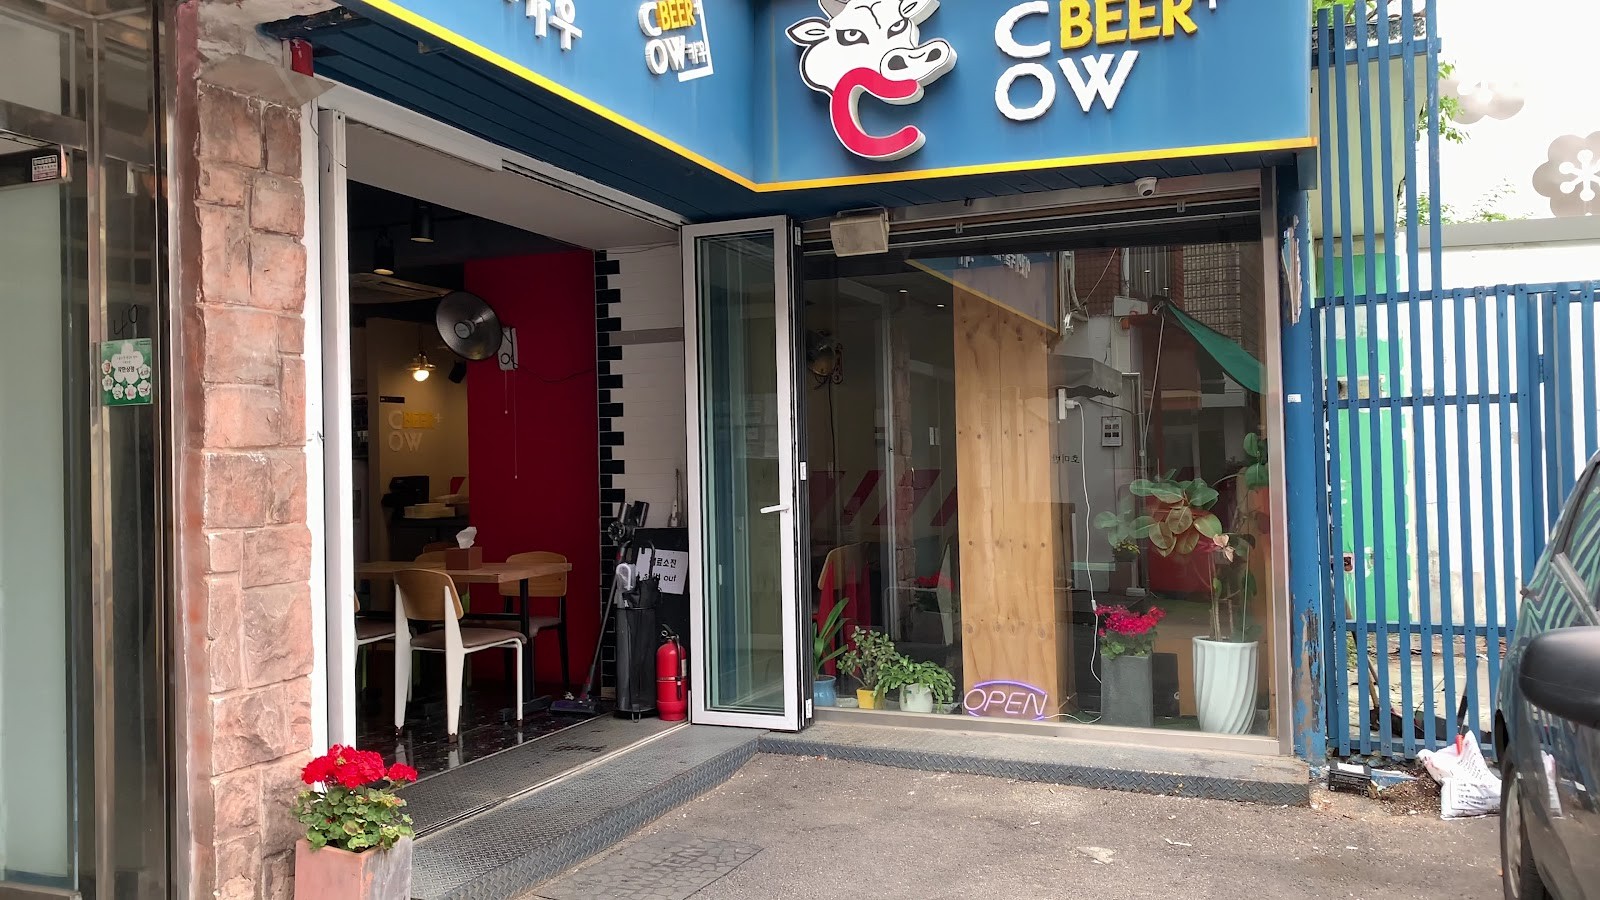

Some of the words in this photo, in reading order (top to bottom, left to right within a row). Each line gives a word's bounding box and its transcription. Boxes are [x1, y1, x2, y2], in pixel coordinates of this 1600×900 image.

[994, 50, 1139, 121] OW
[653, 557, 677, 569] 료소진
[663, 573, 677, 582] out
[963, 688, 1048, 716] OPEN
